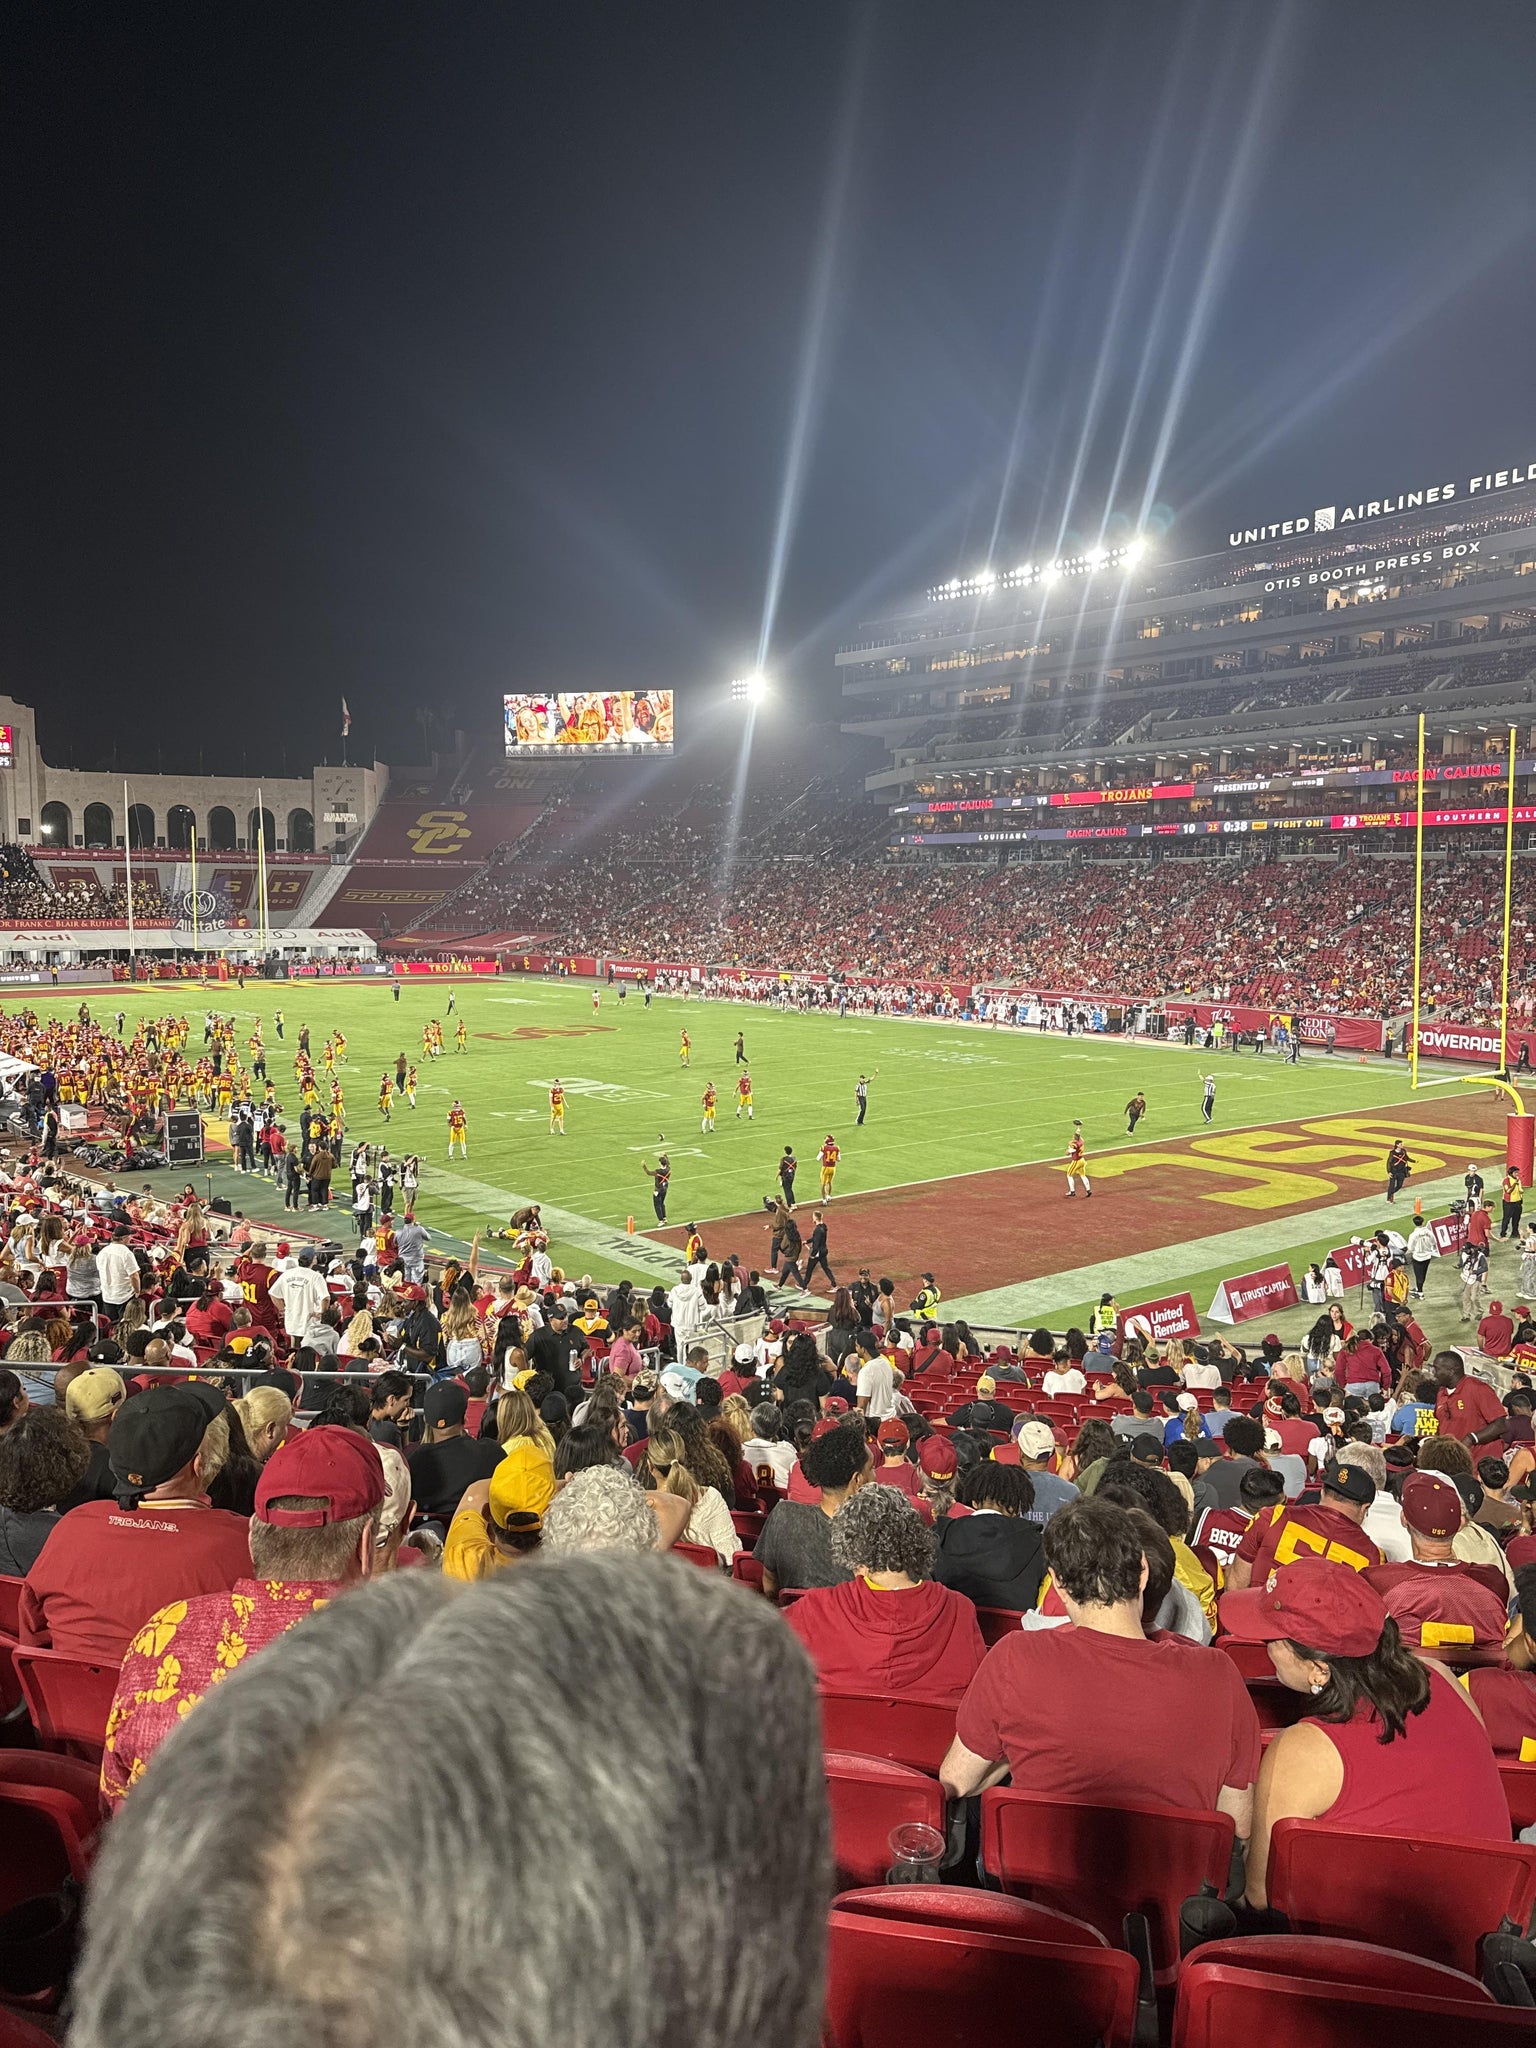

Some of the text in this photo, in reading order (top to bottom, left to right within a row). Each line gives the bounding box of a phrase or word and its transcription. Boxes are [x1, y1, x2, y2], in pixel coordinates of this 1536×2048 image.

[1229, 463, 1536, 546] UNITED AIRLINES FIELD
[1264, 541, 1482, 593] OTIS BOOTH PRESS BOX
[959, 799, 993, 810] CAJUNS
[1100, 788, 1153, 801] TROJANS
[1213, 782, 1258, 793] PRESENTED
[1259, 781, 1271, 791] BY
[1443, 764, 1501, 779] CAJUNS
[978, 832, 1028, 841] LOUISIANA
[1095, 826, 1127, 837] CAJUNS
[1183, 823, 1196, 834] 10
[1223, 820, 1248, 832] 0:38
[1274, 819, 1303, 829] FIGHT
[1306, 818, 1324, 828] ON!
[1343, 816, 1357, 827] 28
[1436, 812, 1500, 822] SOUTHERN
[223, 881, 242, 892] 5
[270, 881, 300, 893] 13
[175, 918, 226, 933] Allstate
[453, 1115, 464, 1125] 15
[825, 1151, 837, 1162] 14
[598, 1237, 690, 1268] APITAL
[241, 1281, 257, 1304] 31
[1150, 1303, 1184, 1324] United
[1153, 1318, 1190, 1338] Rentals
[1027, 1511, 1044, 1521] THE
[1431, 1528, 1447, 1536] USC
